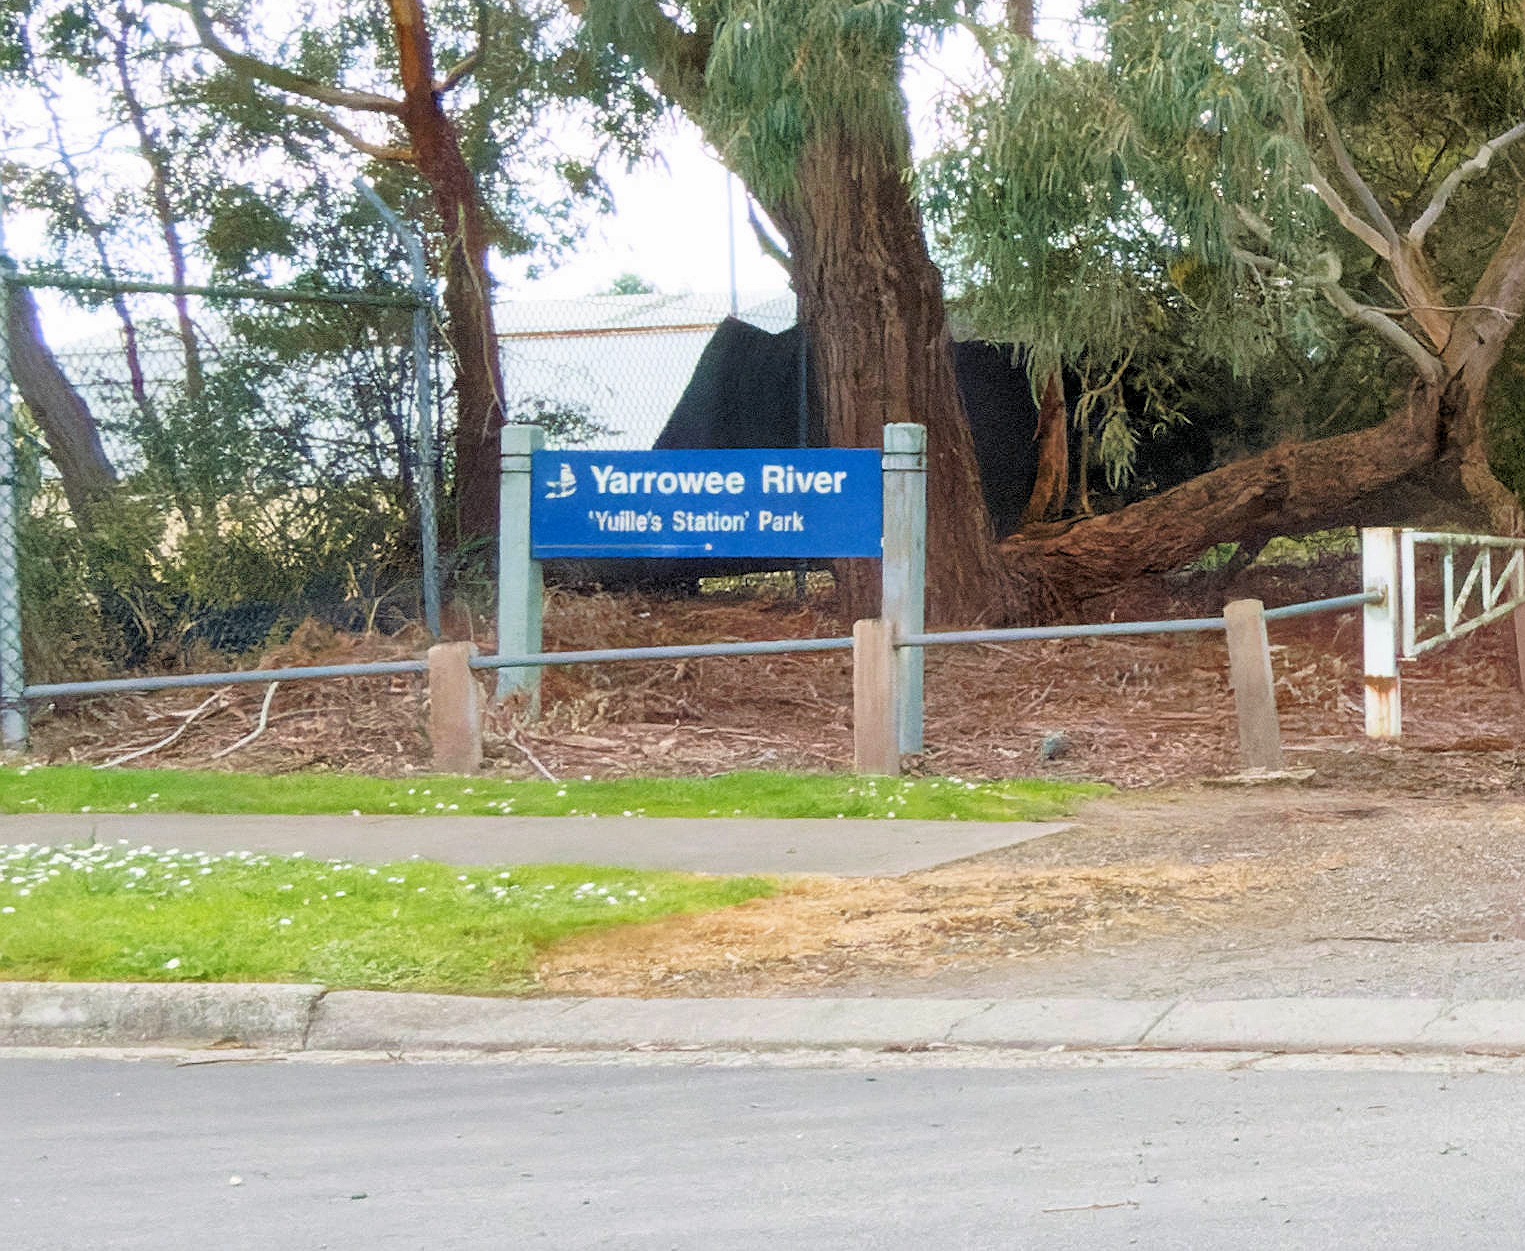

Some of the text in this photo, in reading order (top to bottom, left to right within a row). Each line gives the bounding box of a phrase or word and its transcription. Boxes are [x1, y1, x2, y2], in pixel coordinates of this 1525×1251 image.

[590, 464, 847, 495] Yarrowee River
[758, 510, 804, 532] Park
